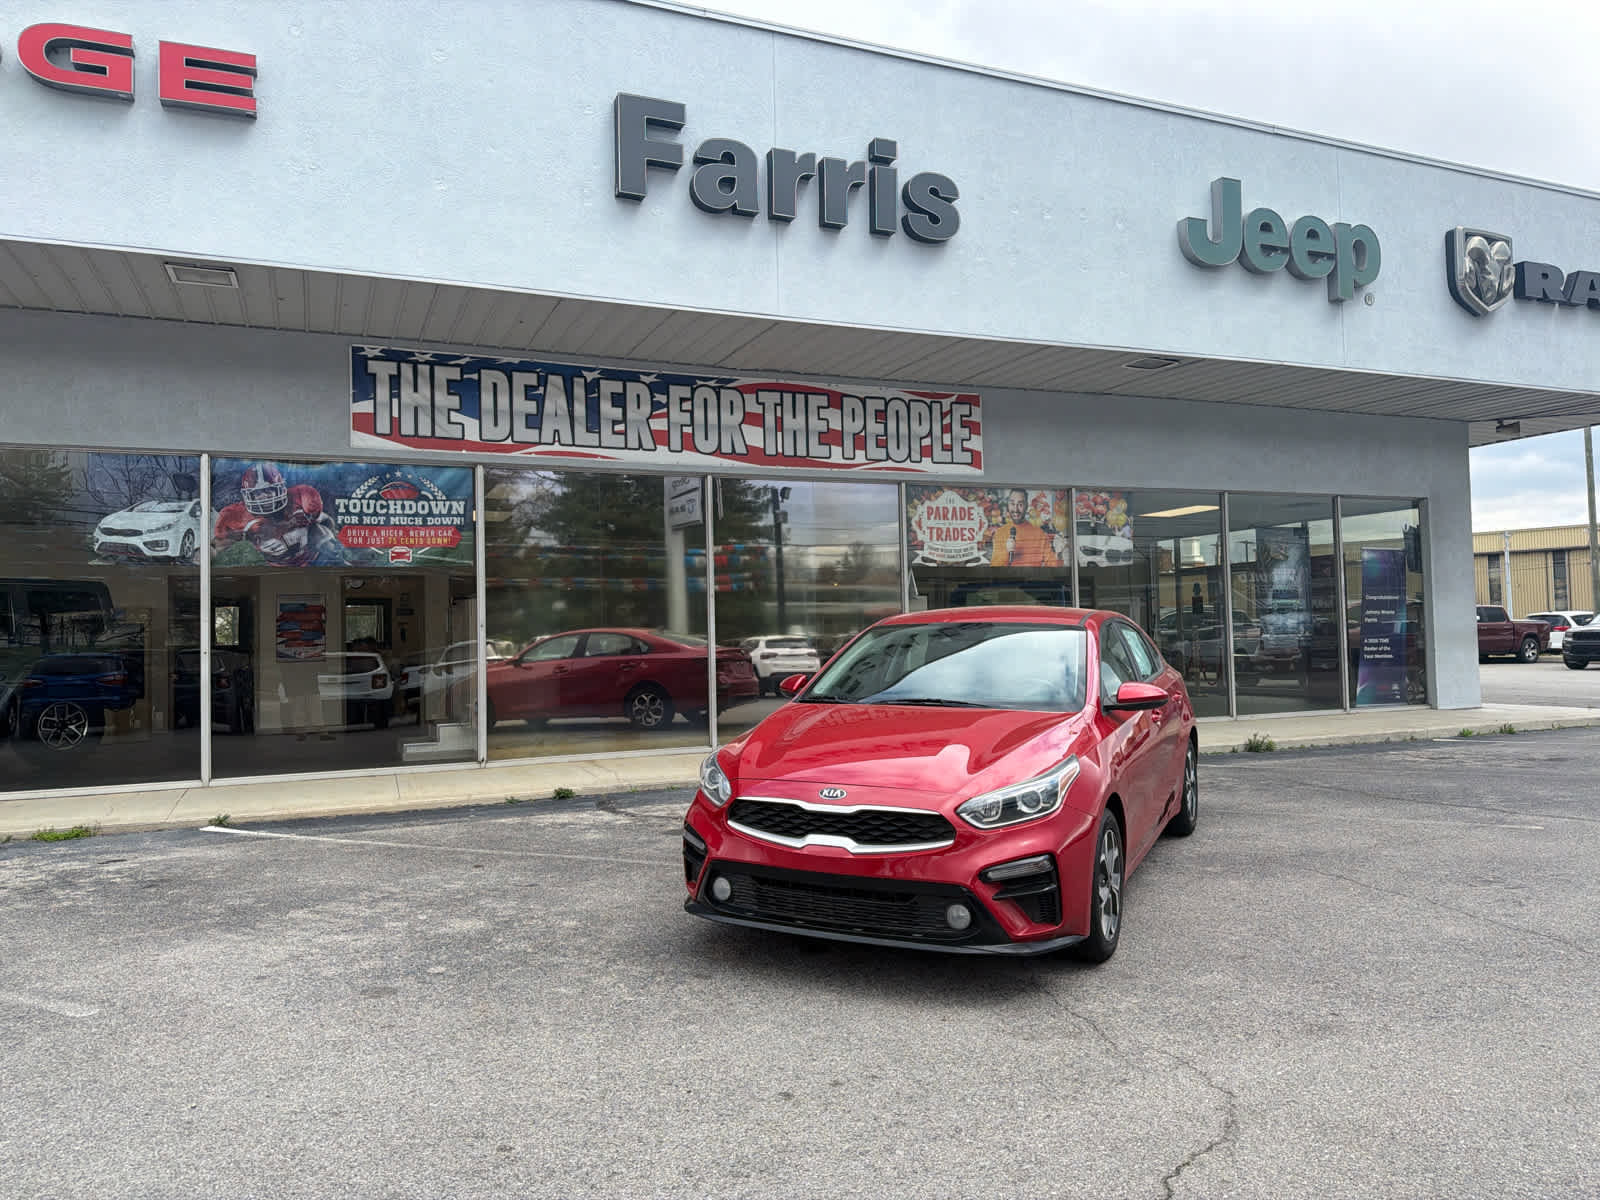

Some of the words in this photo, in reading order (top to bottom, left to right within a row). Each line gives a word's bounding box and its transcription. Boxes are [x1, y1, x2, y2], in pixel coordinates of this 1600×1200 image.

[613, 91, 961, 244] Farris
[1177, 176, 1382, 304] Jeep
[366, 359, 465, 440] THE
[479, 368, 657, 451] DEALER
[667, 383, 748, 456] FOR
[755, 389, 832, 459] THE
[841, 395, 974, 464] PEOPLE
[335, 498, 466, 515] TOUCHDOWN
[926, 506, 975, 521] PARADE
[337, 515, 359, 525] FOR
[362, 515, 386, 525] NOT
[390, 516, 423, 525] MUCH
[427, 516, 465, 526] DOWN!
[347, 528, 368, 537] DRIVE
[927, 526, 976, 542] TRADES
[348, 537, 362, 545] FOR
[366, 537, 385, 545] JUST
[821, 788, 842, 797] KIA
